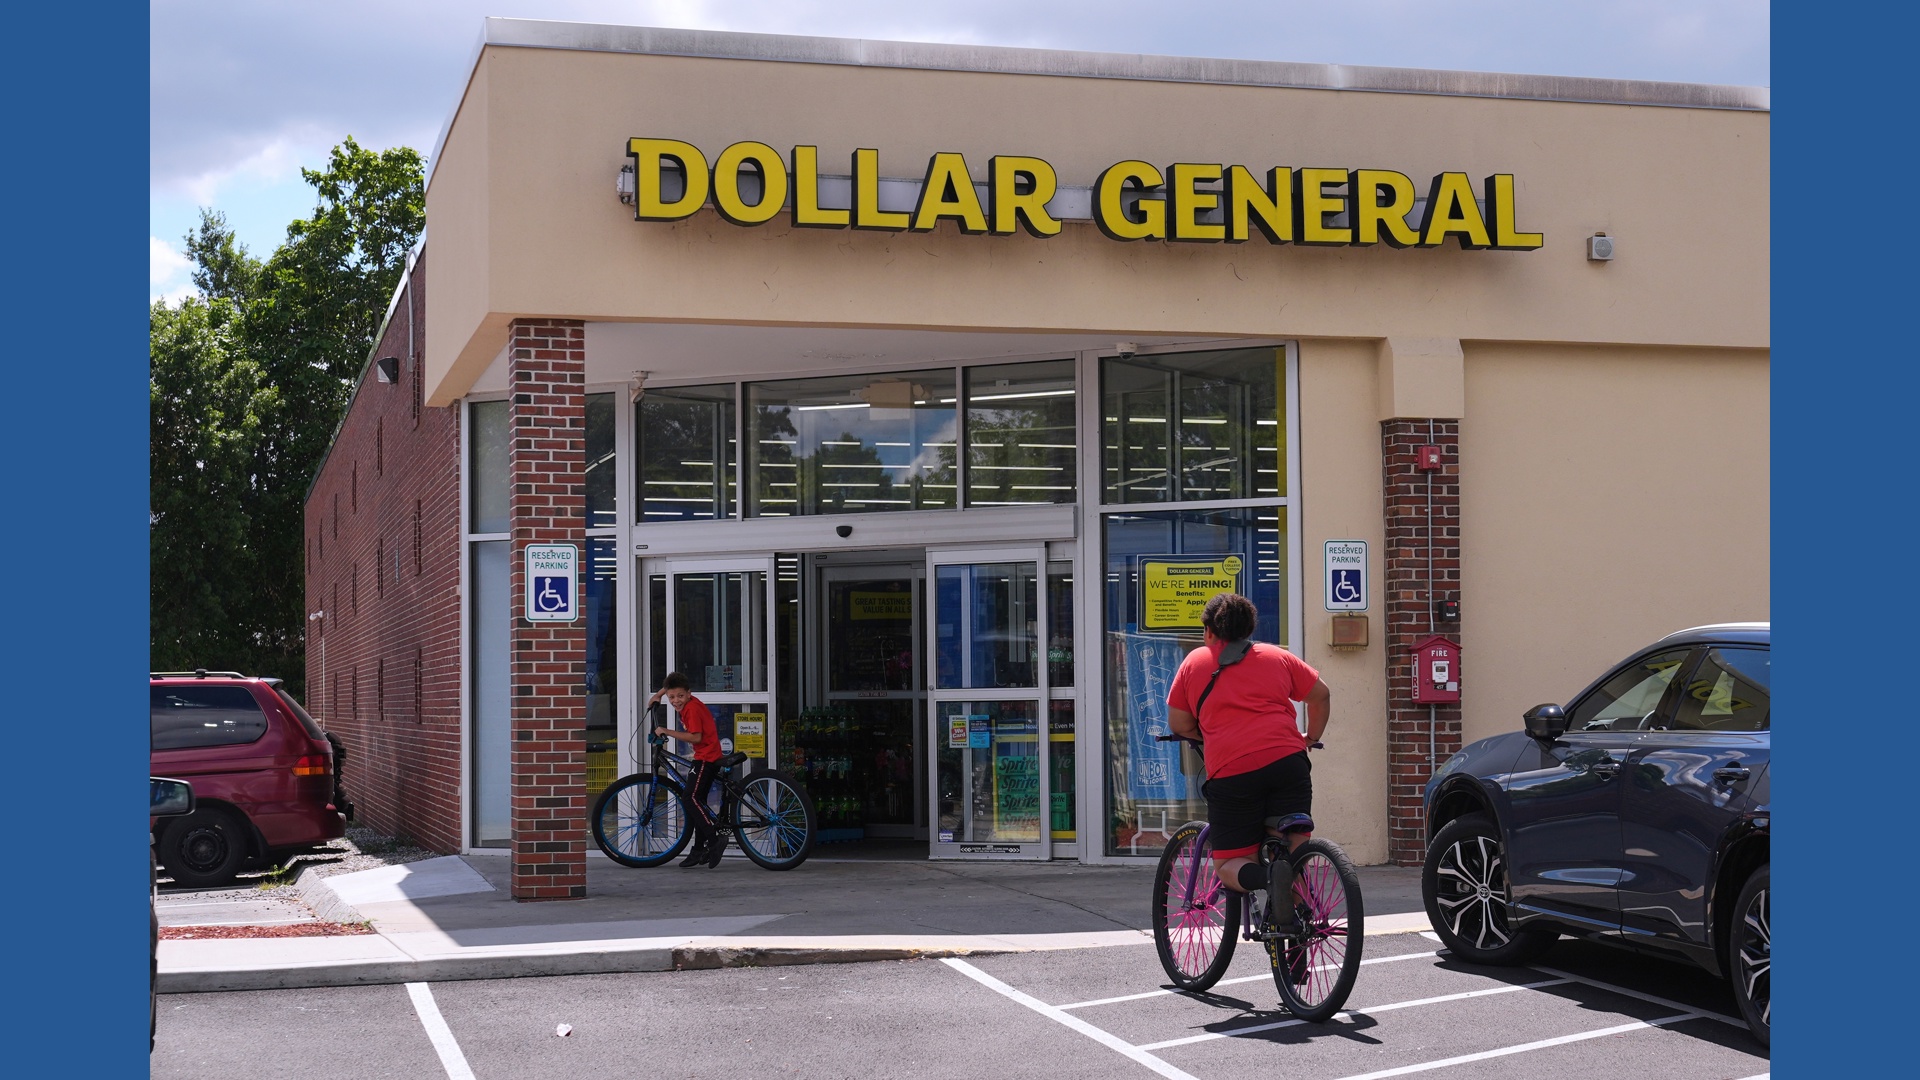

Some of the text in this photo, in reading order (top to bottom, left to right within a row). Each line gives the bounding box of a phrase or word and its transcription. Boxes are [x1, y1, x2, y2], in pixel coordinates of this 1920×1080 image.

[627, 137, 1544, 251] DOLLAR GENERAL
[1329, 547, 1363, 555] RESERVED
[535, 562, 568, 570] PARKING
[1150, 580, 1232, 589] WE'RE HIRING!
[855, 597, 876, 605] GREAT
[878, 597, 906, 605] TASTING
[863, 605, 884, 613] VALUE
[885, 605, 893, 613] IN
[894, 605, 905, 613] ALL
[998, 756, 1036, 773] Sprite
[1001, 775, 1038, 792] Sprite
[1002, 794, 1039, 811] Sprite
[1002, 813, 1039, 828] Sprite
